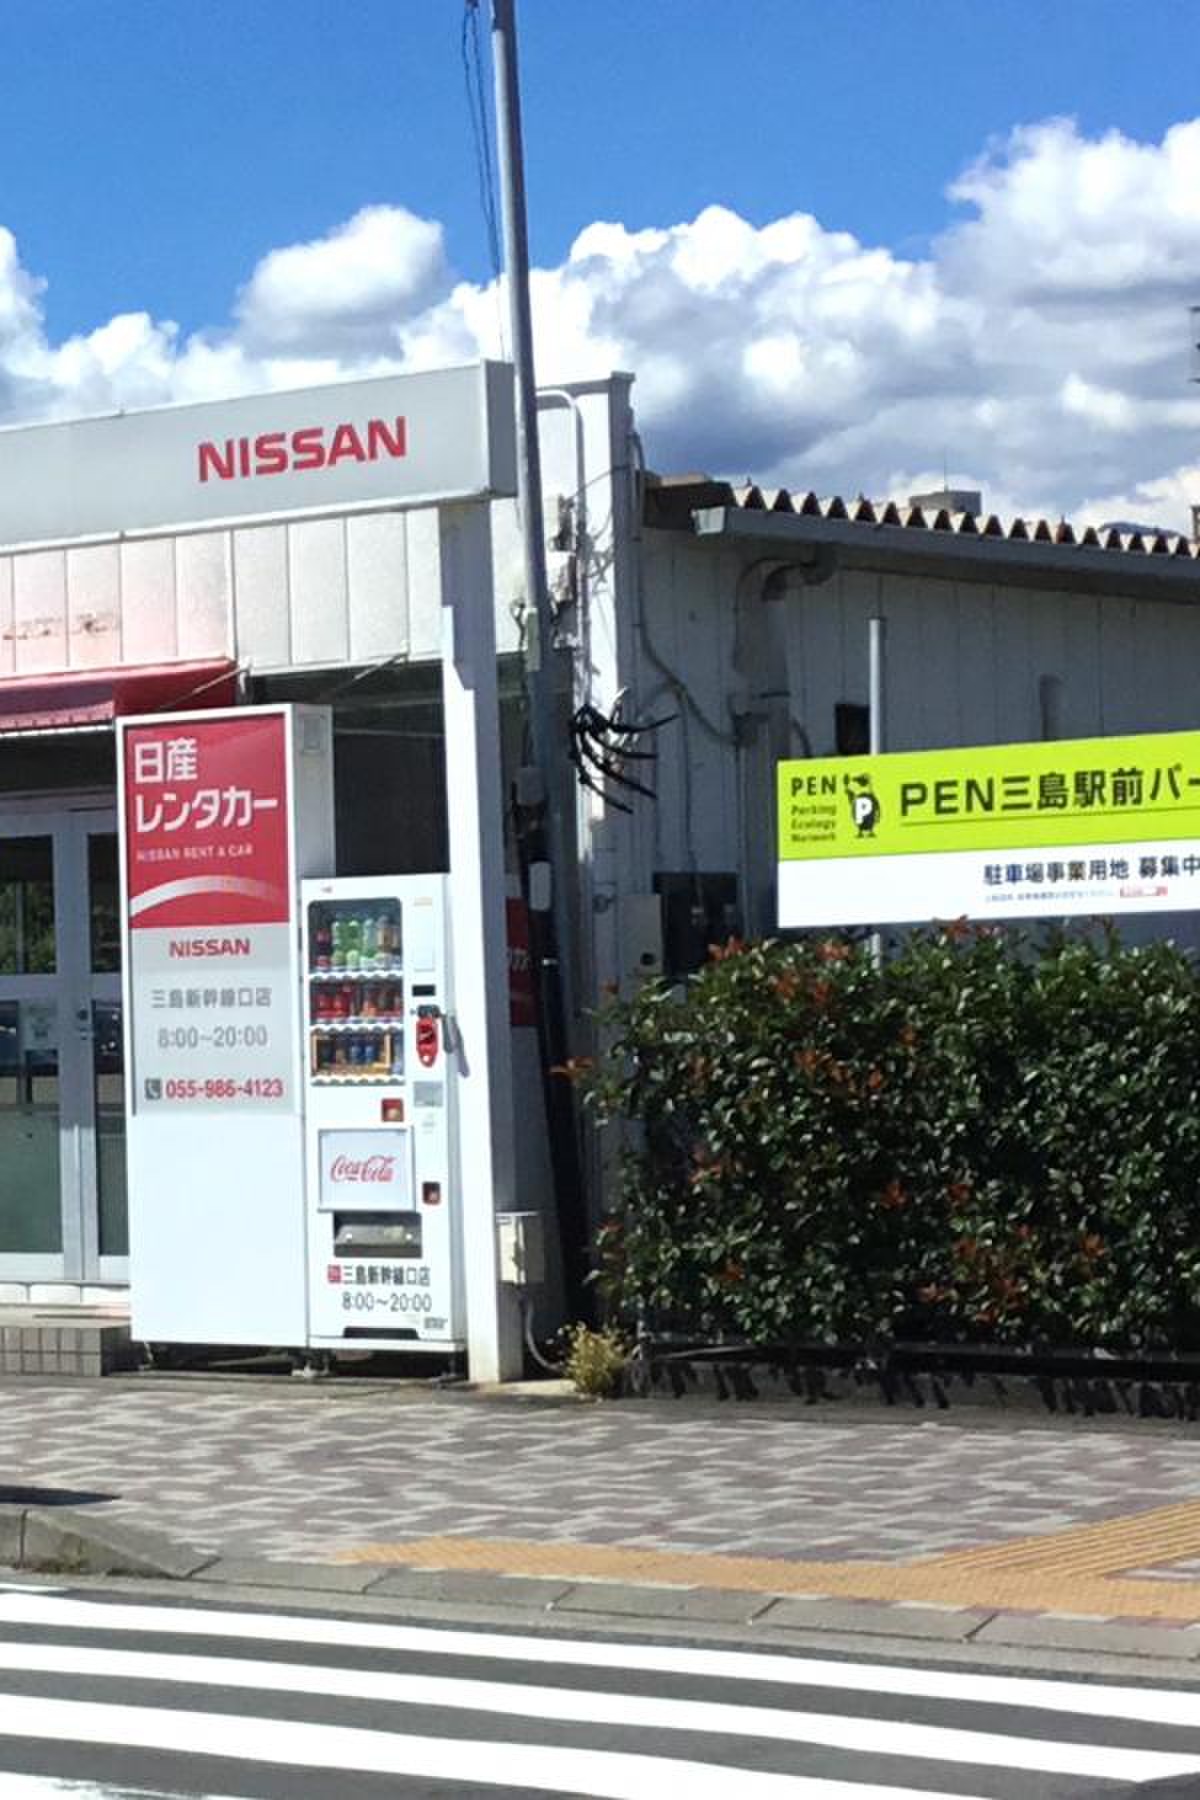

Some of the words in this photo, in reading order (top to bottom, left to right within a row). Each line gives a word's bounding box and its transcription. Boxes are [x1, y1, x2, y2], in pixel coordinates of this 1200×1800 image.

[198, 416, 406, 482] NISSAN
[134, 737, 198, 783] 日産
[791, 775, 836, 796] PEN
[135, 786, 279, 832] レンタカー
[137, 848, 180, 861] NISSAN
[184, 847, 214, 859] RENT
[218, 846, 227, 857] A
[228, 844, 253, 857] CAR
[984, 859, 1129, 885] 駐車場事業用地
[169, 938, 250, 957] NISSAN
[152, 988, 272, 1008] 三島新幹線口店
[166, 1079, 283, 1098] 055-986-4123
[344, 1265, 430, 1286] 三島新幹線口店
